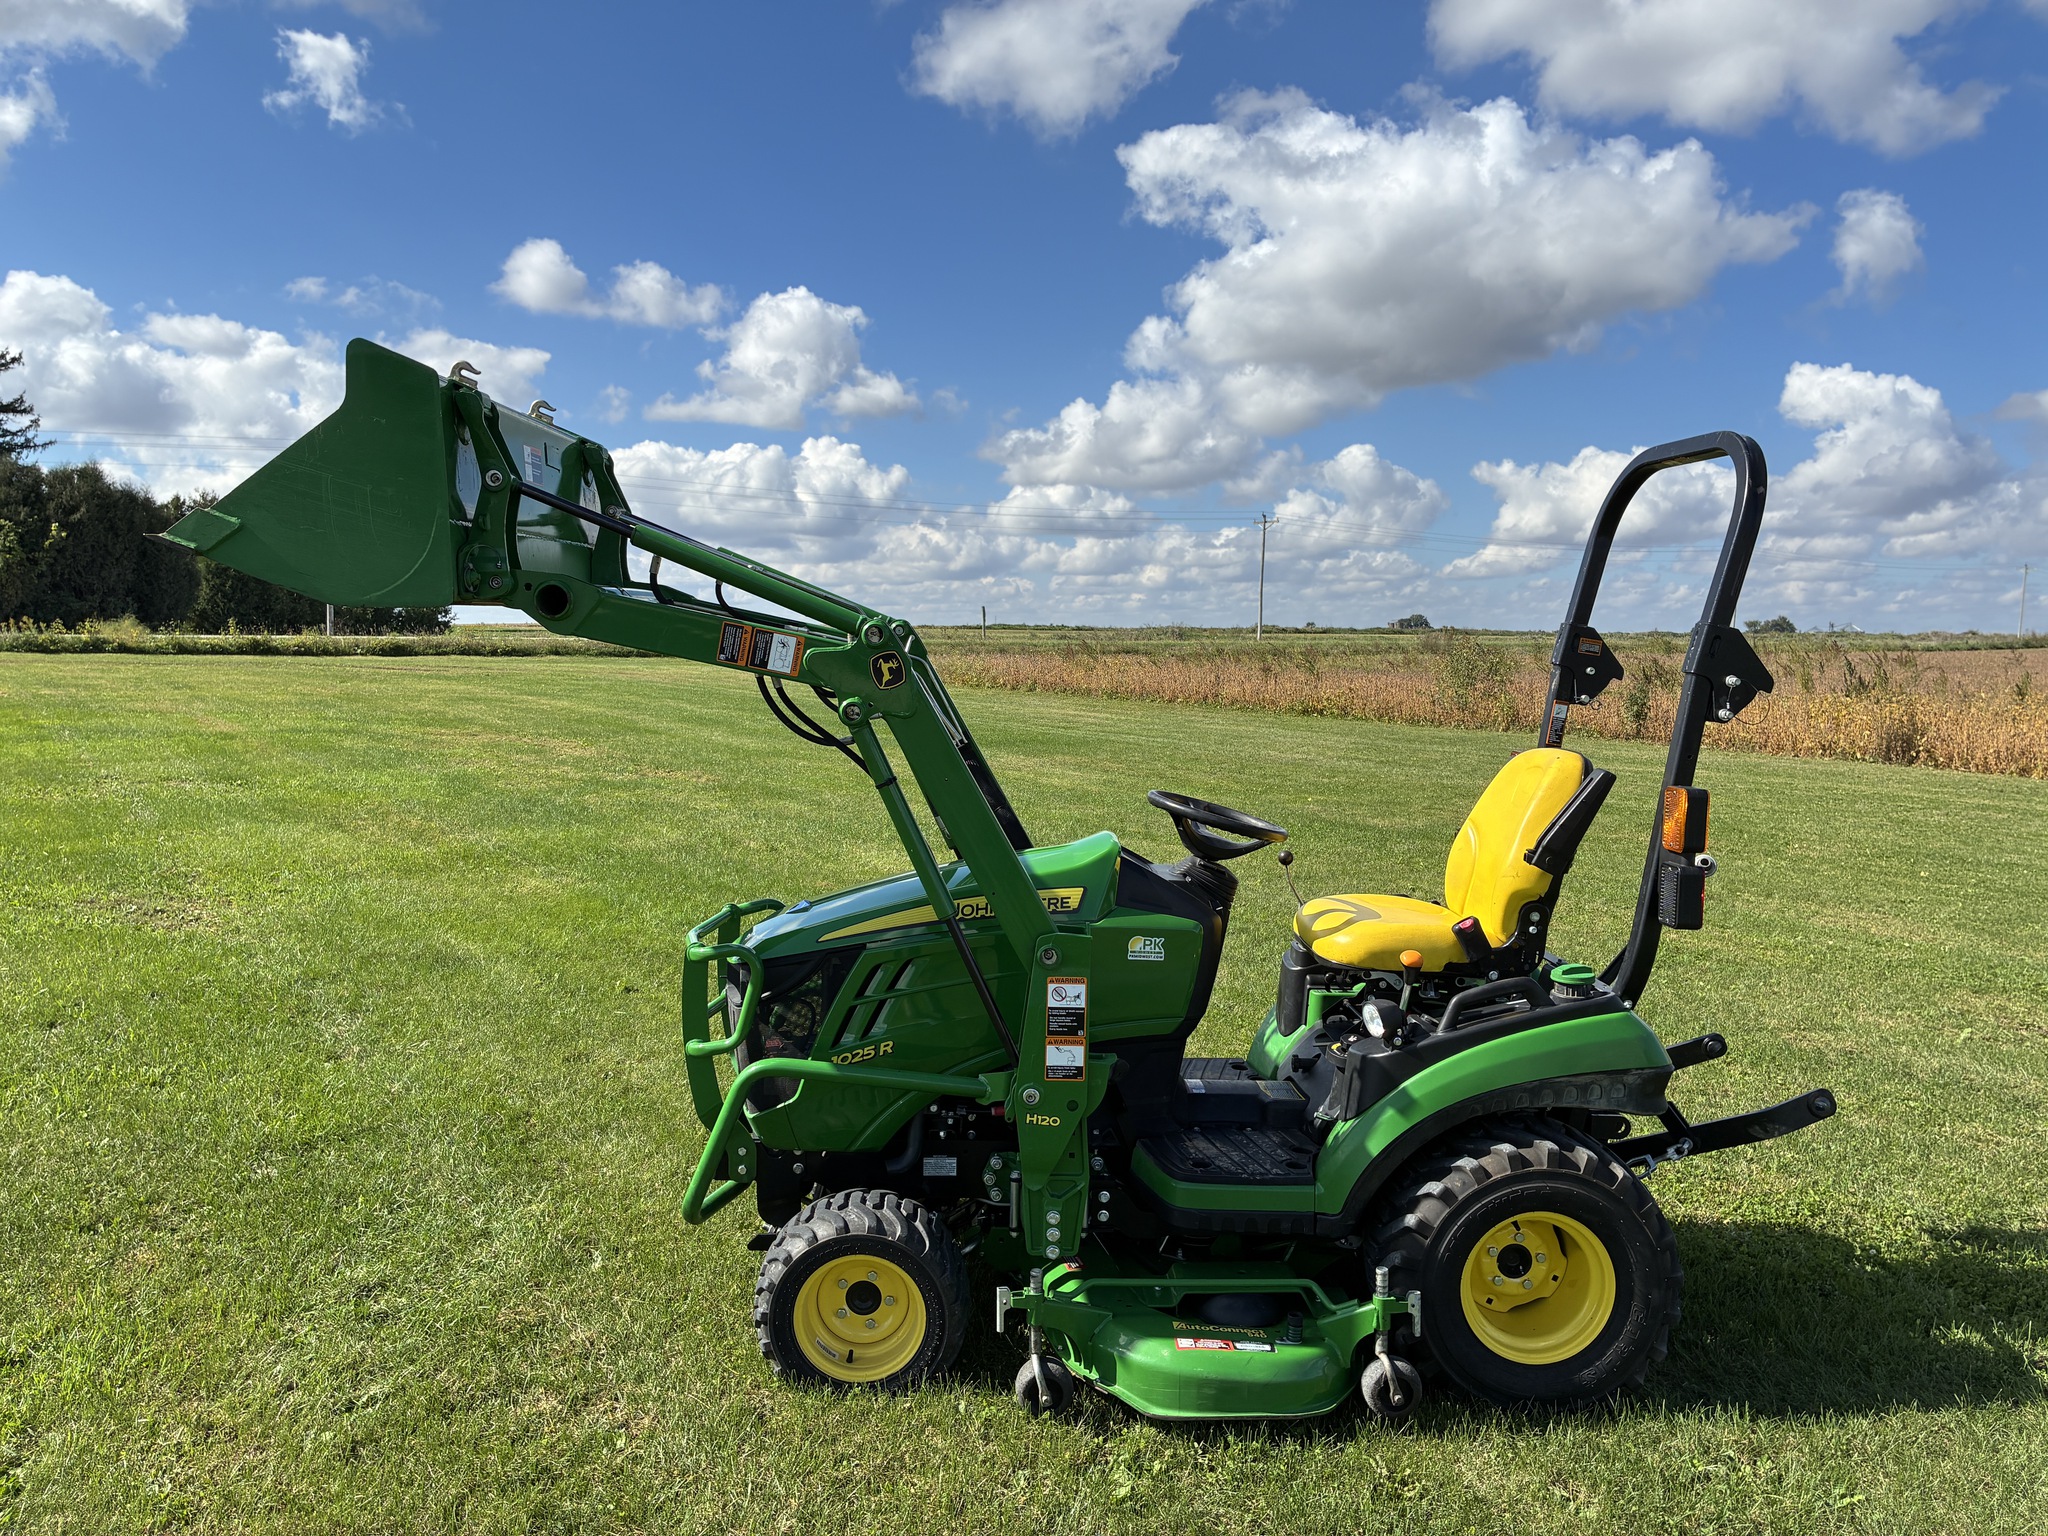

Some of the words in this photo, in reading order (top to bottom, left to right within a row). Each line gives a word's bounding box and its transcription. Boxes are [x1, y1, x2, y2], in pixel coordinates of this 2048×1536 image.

[740, 636, 748, 662] WARNING
[793, 646, 801, 672] WARNING
[956, 902, 993, 917] JOH
[1143, 938, 1164, 951] PK
[831, 1045, 876, 1065] 1025
[879, 1040, 894, 1056] R
[1026, 1113, 1061, 1126] H120
[1175, 1321, 1265, 1335] AutoConnect
